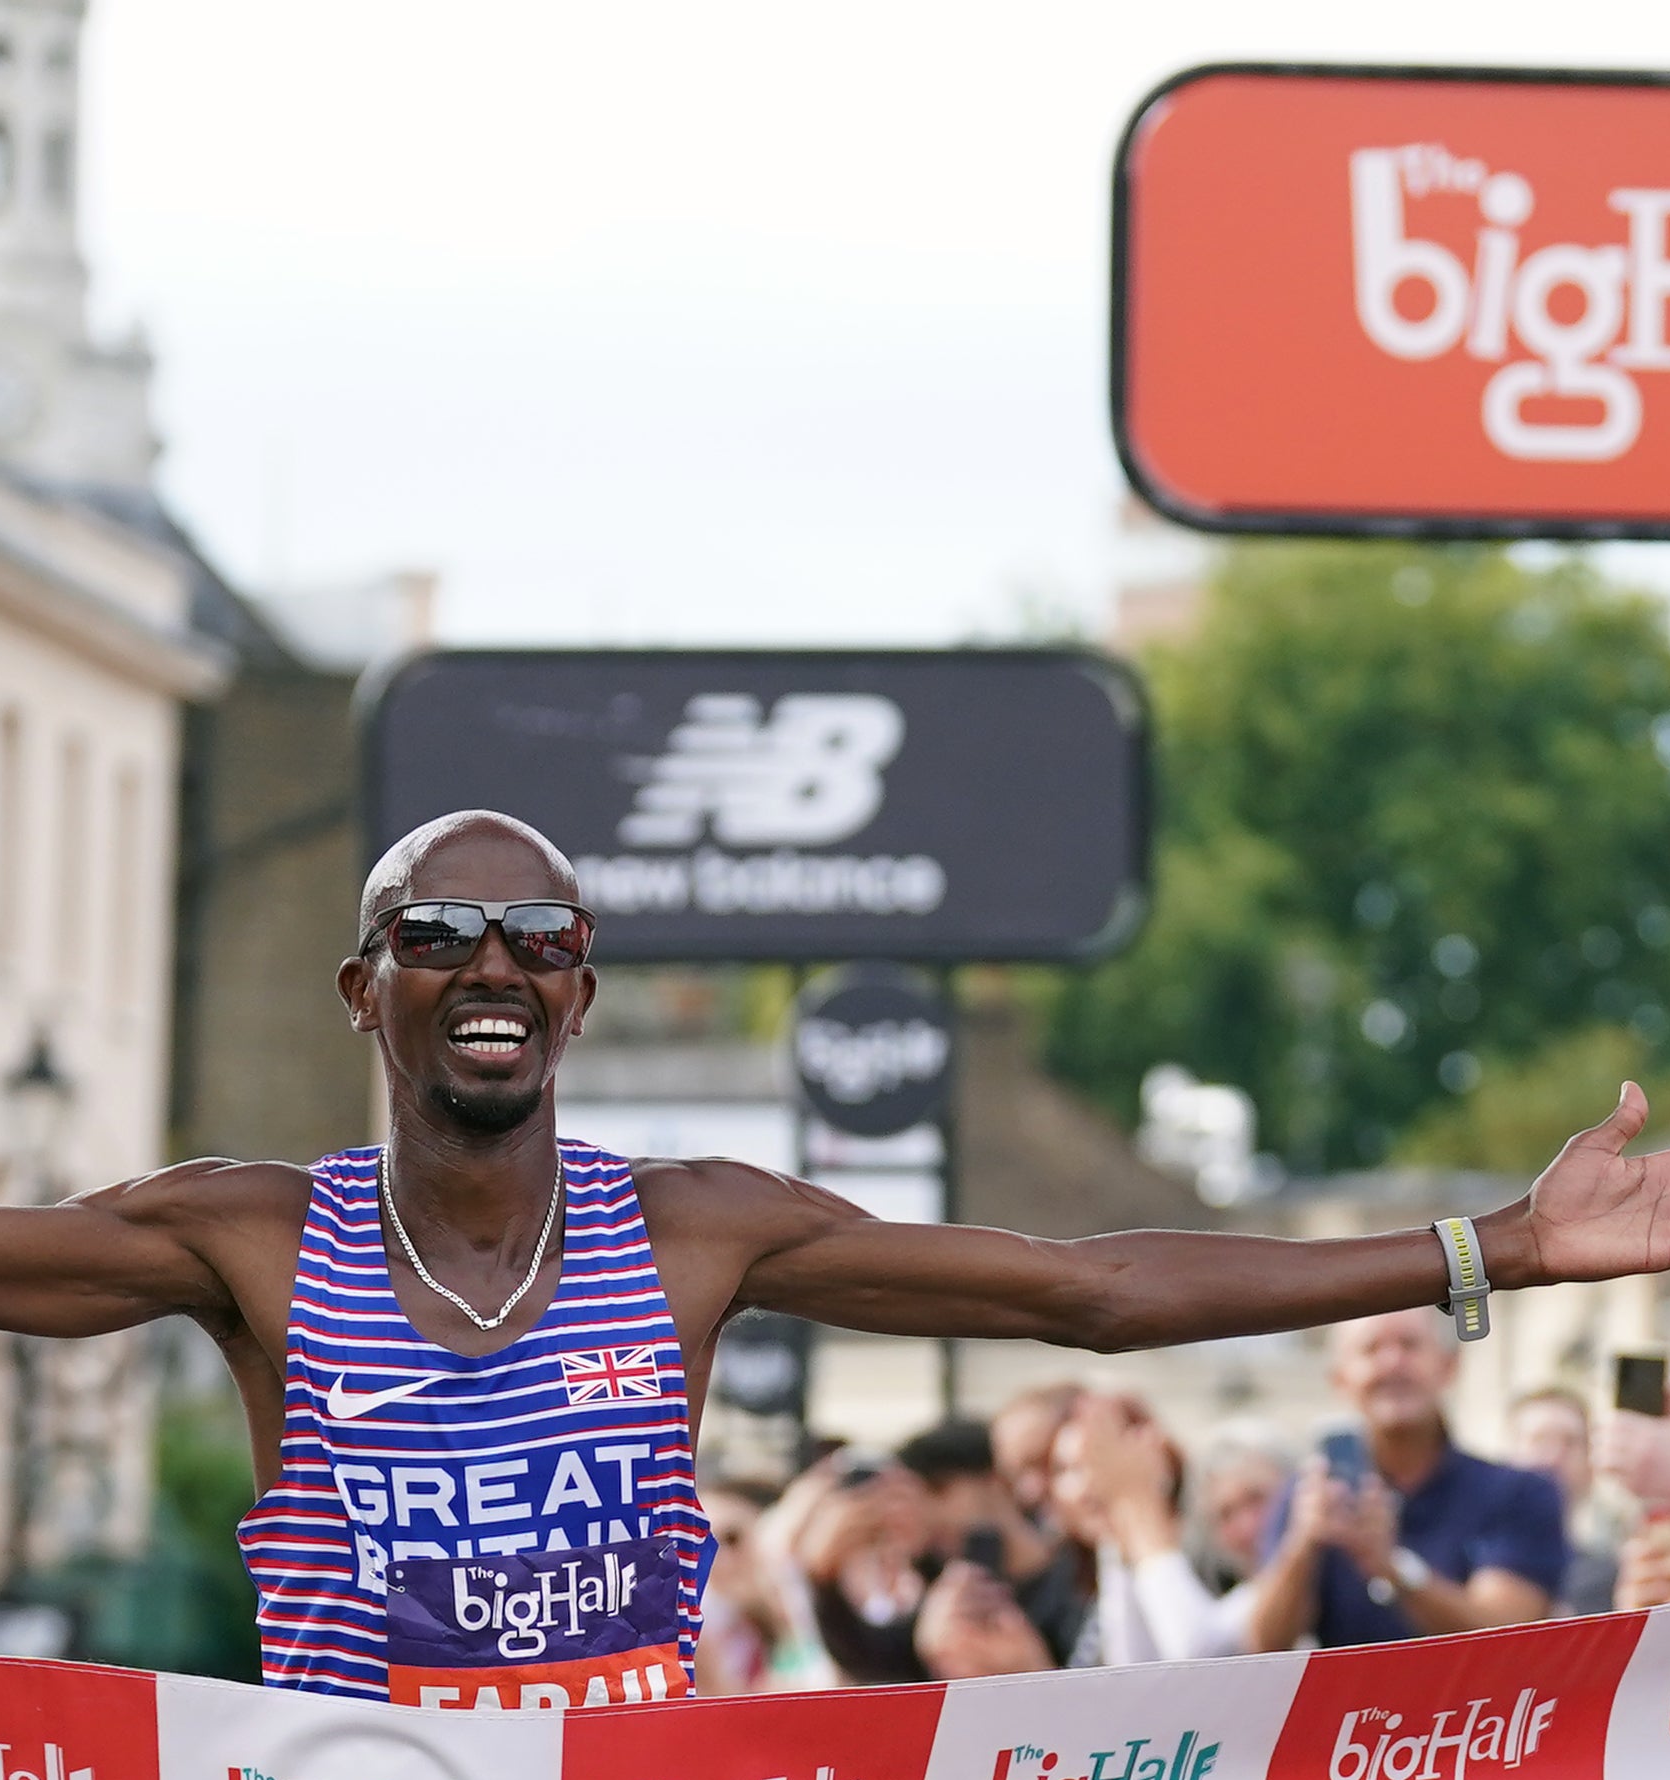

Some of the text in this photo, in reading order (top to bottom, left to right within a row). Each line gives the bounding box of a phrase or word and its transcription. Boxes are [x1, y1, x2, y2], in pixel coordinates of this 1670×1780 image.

[333, 1442, 651, 1528] GREAT
[468, 1566, 494, 1580] The
[1359, 1706, 1391, 1724] The
[1014, 1744, 1045, 1764] The
